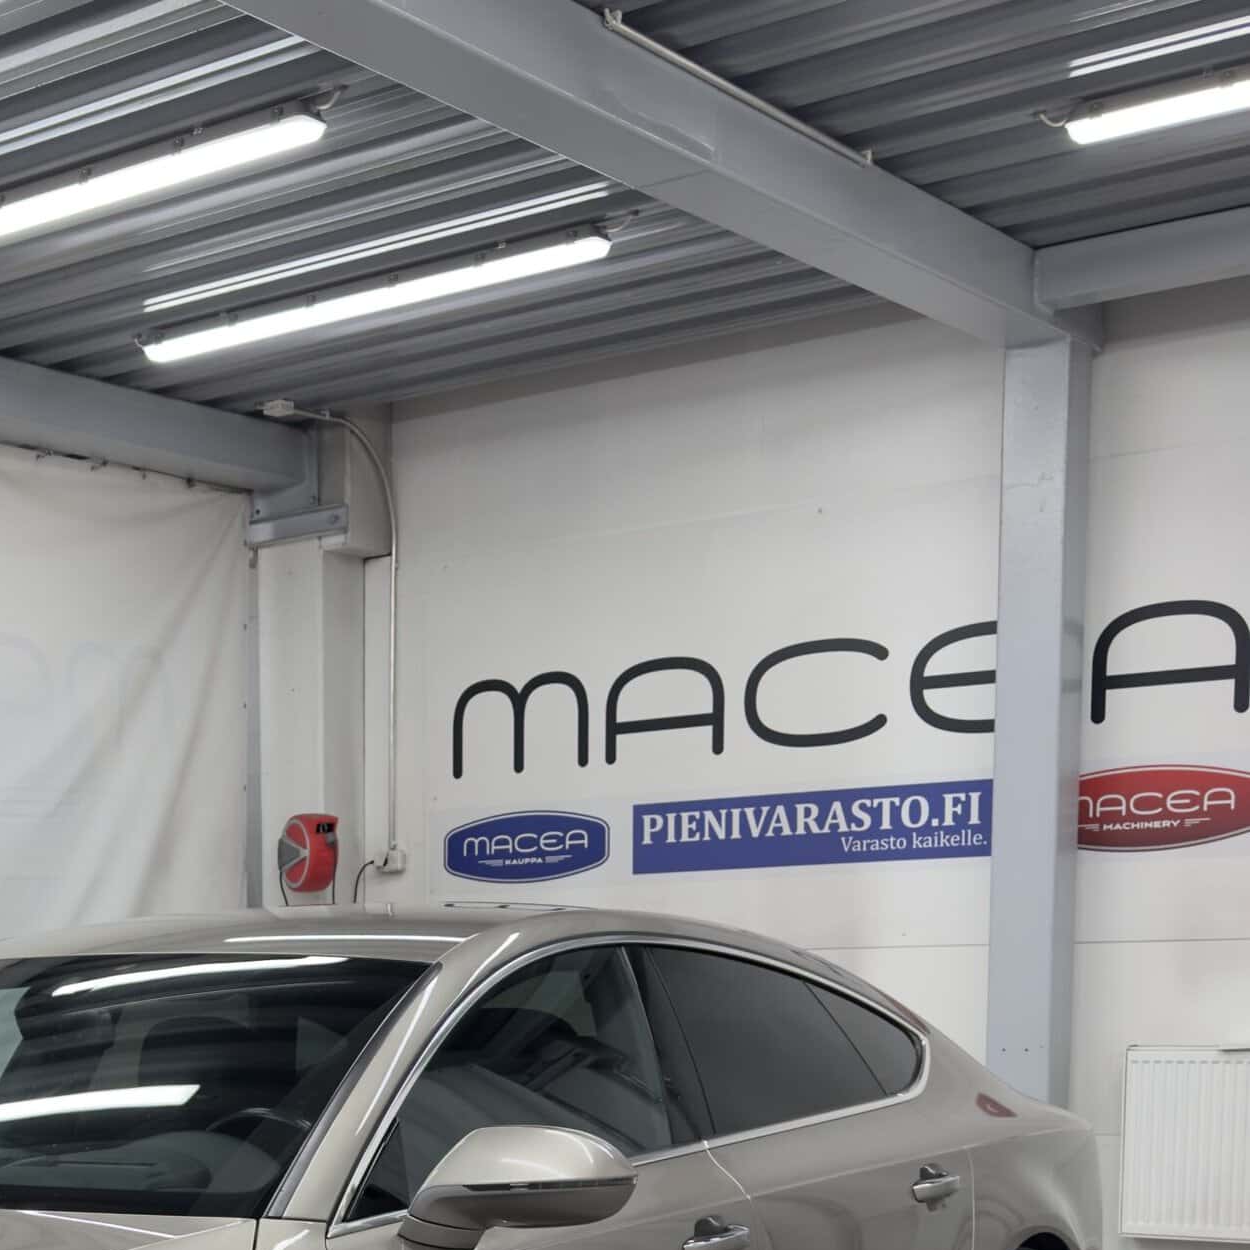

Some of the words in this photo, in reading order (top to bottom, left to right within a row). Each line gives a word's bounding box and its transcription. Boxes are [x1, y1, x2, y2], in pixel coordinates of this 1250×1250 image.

[640, 791, 983, 845] PIENIVARASTO.FI
[1102, 819, 1181, 831] MACHINERY
[463, 829, 589, 857] MACEA
[840, 836, 907, 853] Varasto
[911, 829, 988, 850] kaikelle.
[504, 857, 543, 865] KAUPPA
